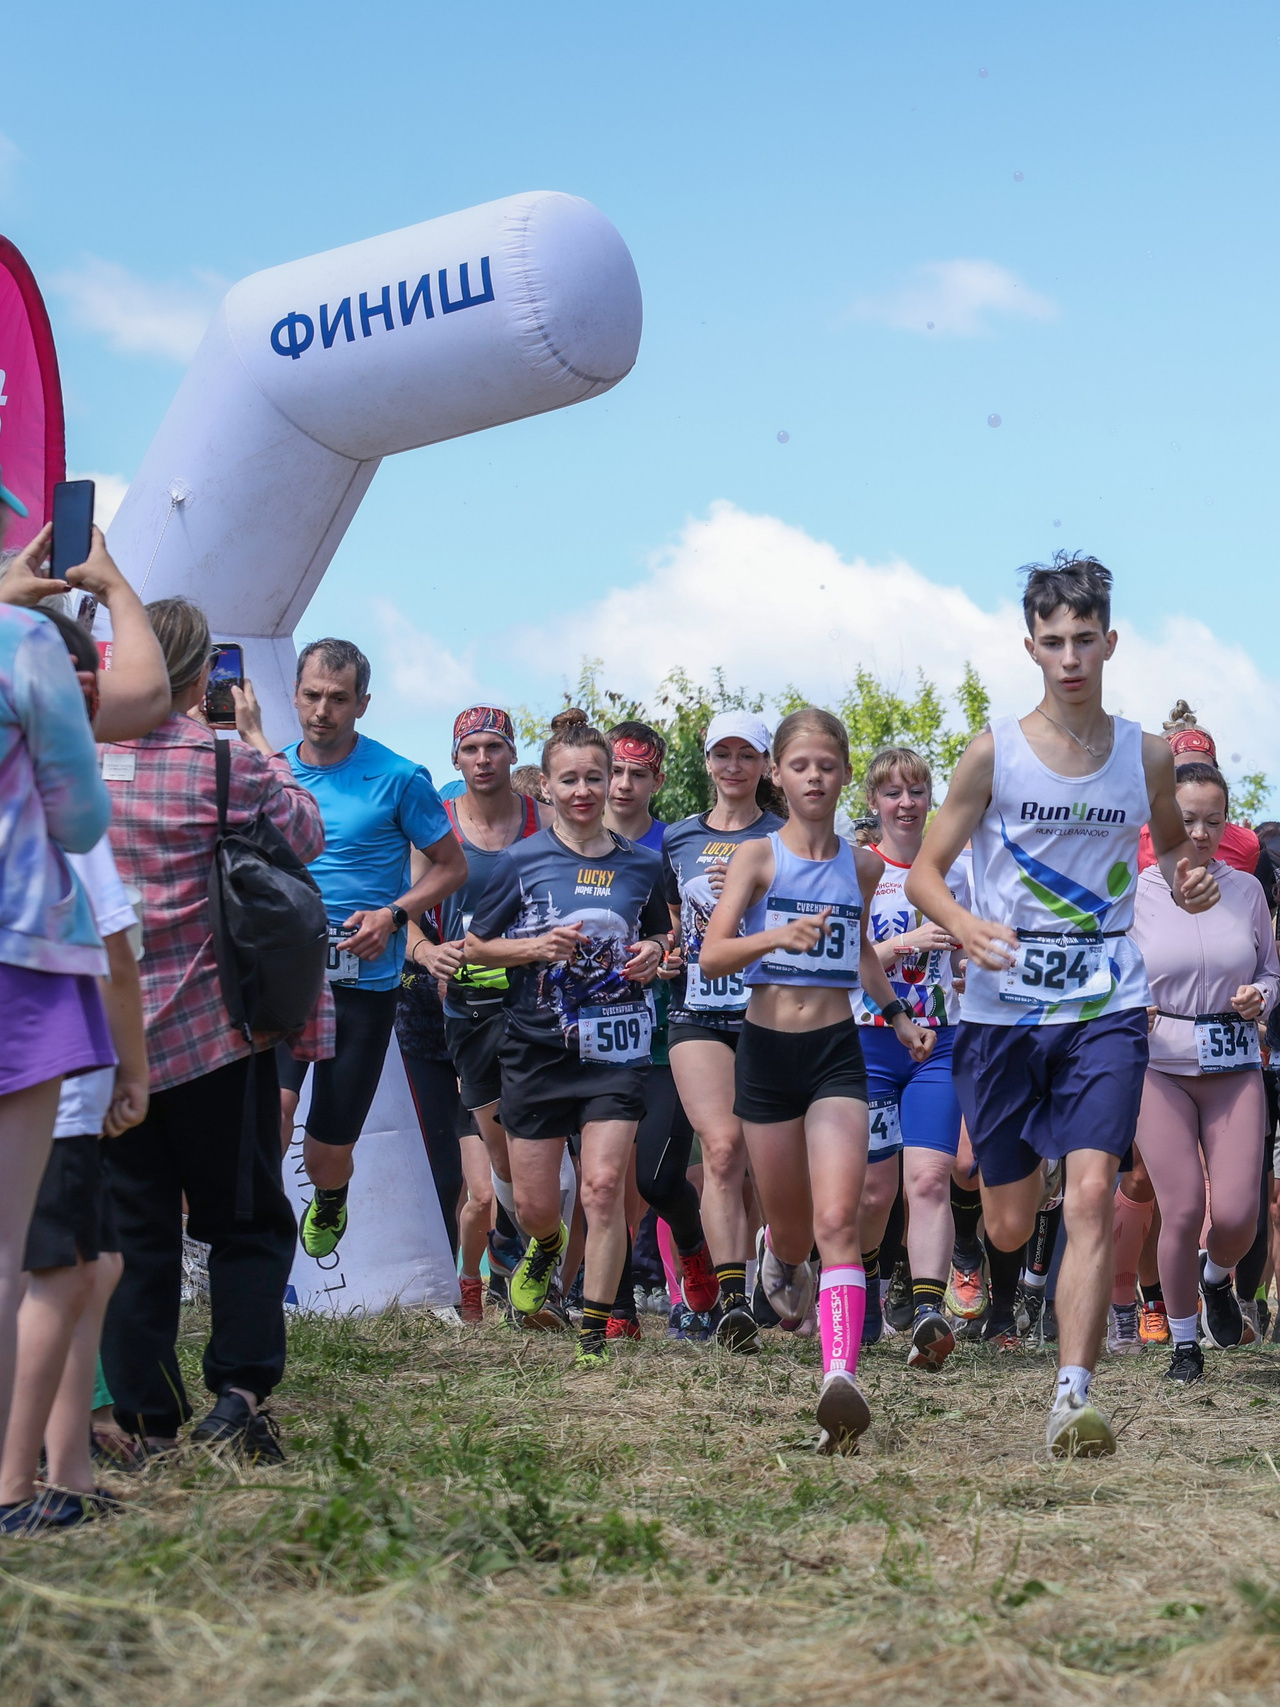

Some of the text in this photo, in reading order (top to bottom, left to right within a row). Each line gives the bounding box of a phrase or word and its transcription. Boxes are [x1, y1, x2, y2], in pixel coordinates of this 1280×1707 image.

[270, 255, 495, 360] ФИНИШ
[1020, 802, 1126, 823] Run4fun
[702, 841, 740, 857] LUCKY
[574, 885, 611, 897] HOME TRAIL
[577, 868, 616, 888] LUCKY
[1022, 948, 1088, 989] 524
[597, 1018, 640, 1052] 509
[1209, 1026, 1249, 1057] 534
